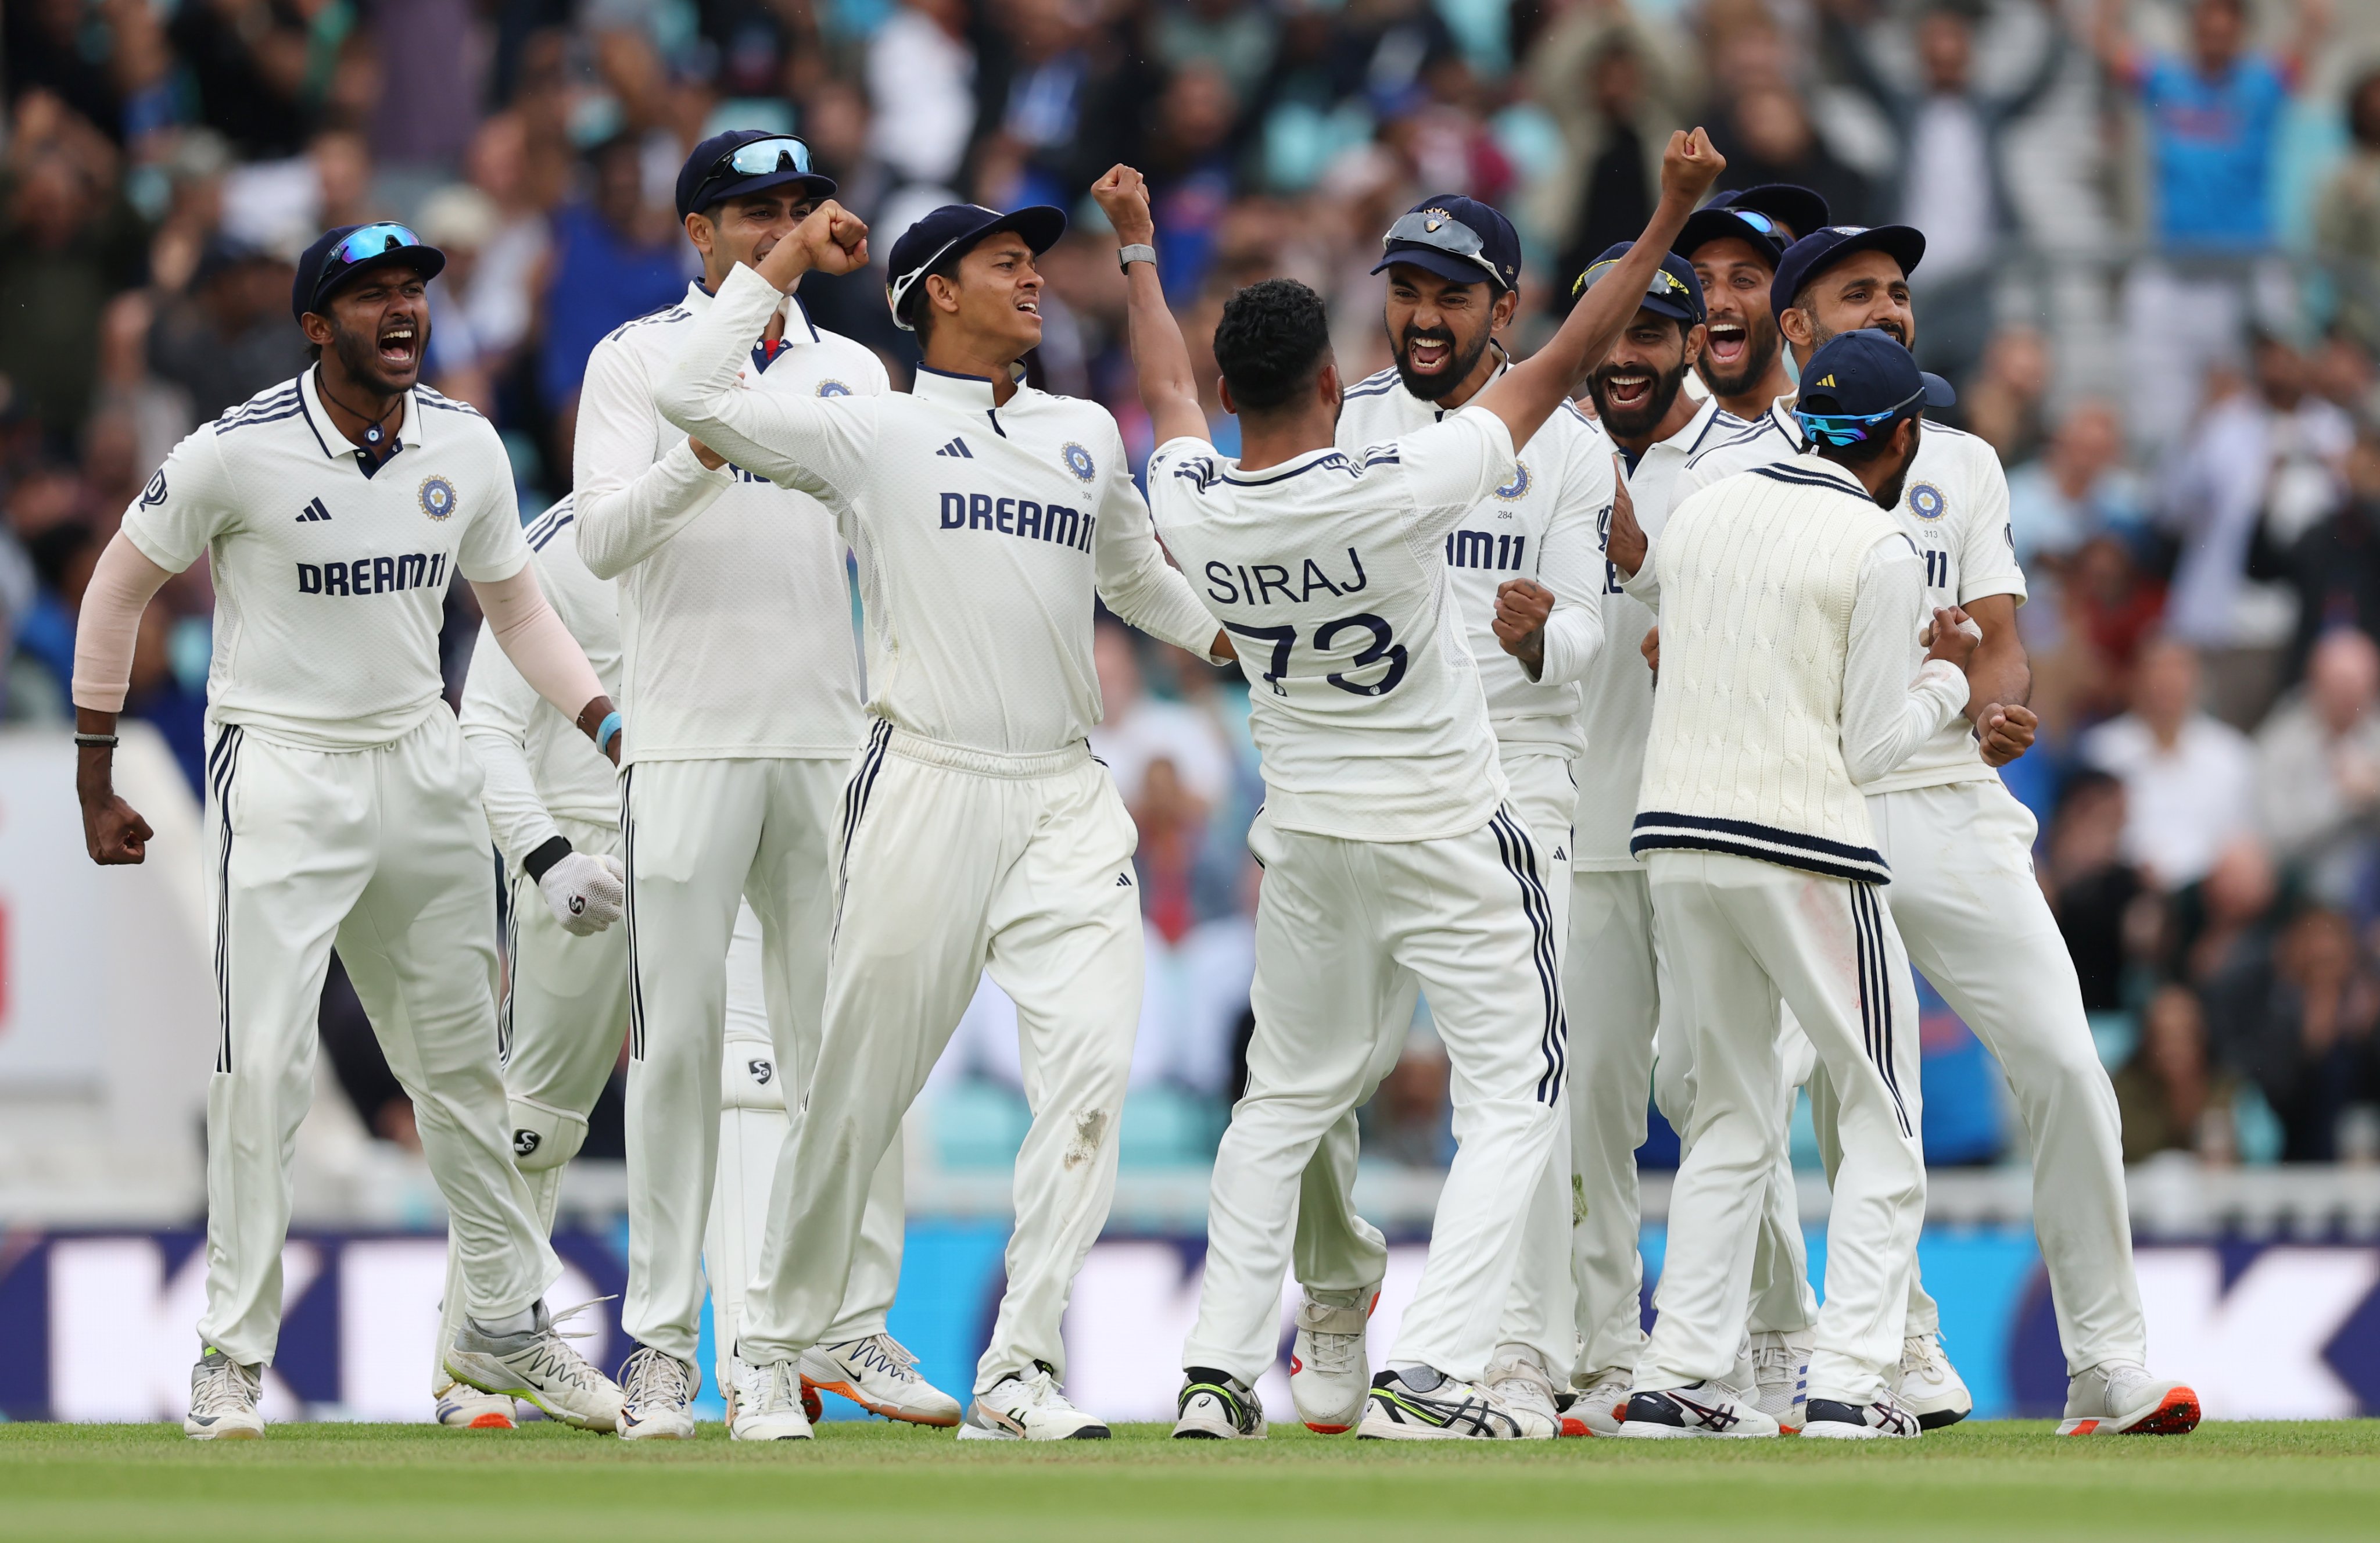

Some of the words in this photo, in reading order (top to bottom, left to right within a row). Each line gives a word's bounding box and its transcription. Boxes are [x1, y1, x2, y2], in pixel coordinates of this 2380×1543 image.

[1082, 491, 1092, 501] 306
[1497, 510, 1512, 520] 284
[938, 492, 1096, 554] DREAM11
[1924, 530, 1938, 539] 313
[295, 552, 447, 597] DREAM11
[1205, 547, 1367, 606] SIRAJ
[1221, 613, 1408, 697] 73
